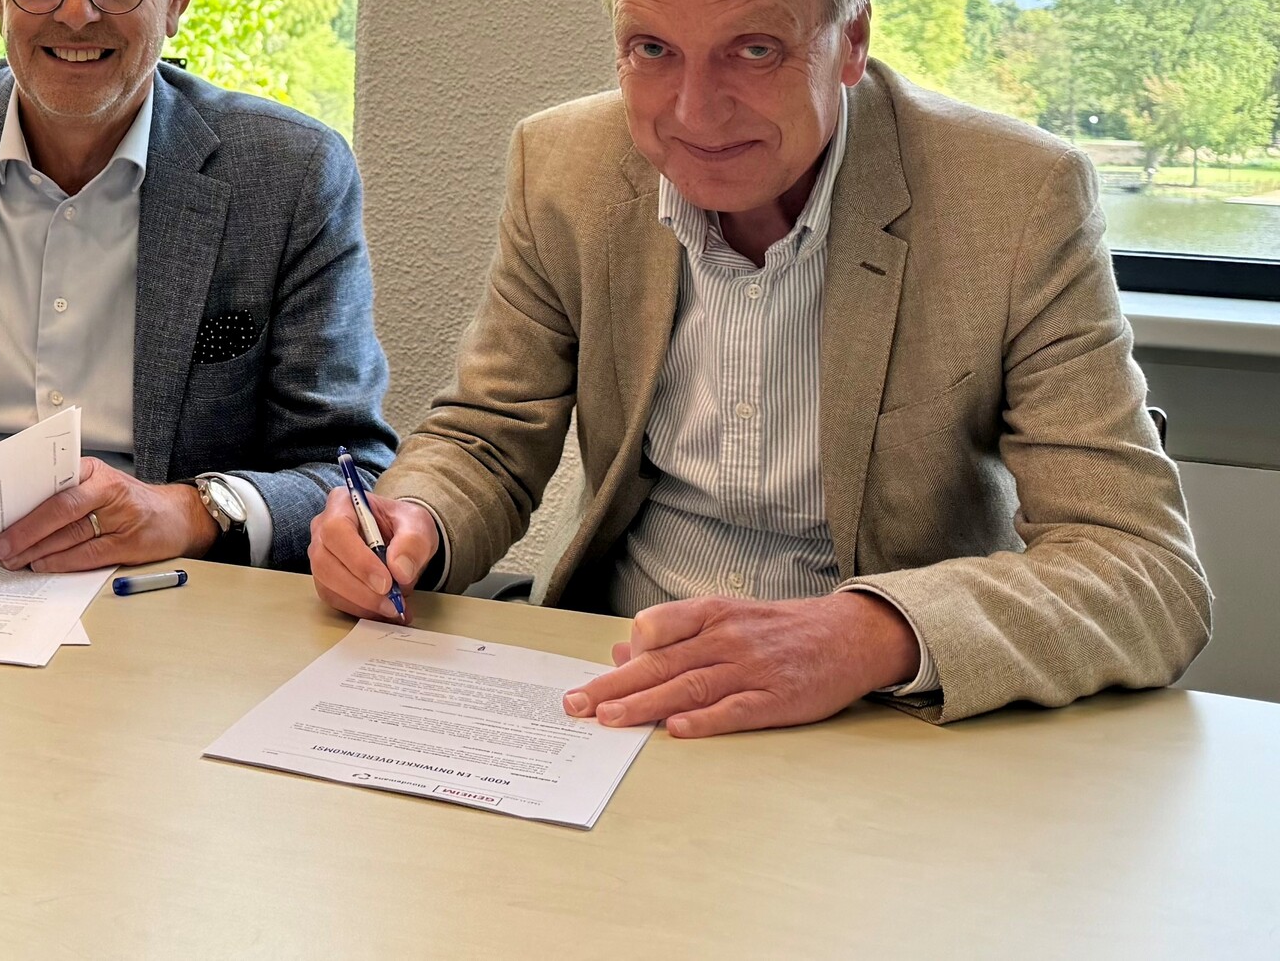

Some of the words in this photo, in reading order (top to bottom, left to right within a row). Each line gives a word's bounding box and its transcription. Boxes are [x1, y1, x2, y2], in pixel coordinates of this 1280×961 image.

[310, 744, 455, 776] ONTWIKKELOVEREENKOMST
[457, 771, 472, 779] EN
[442, 788, 495, 803] GEHEIM
